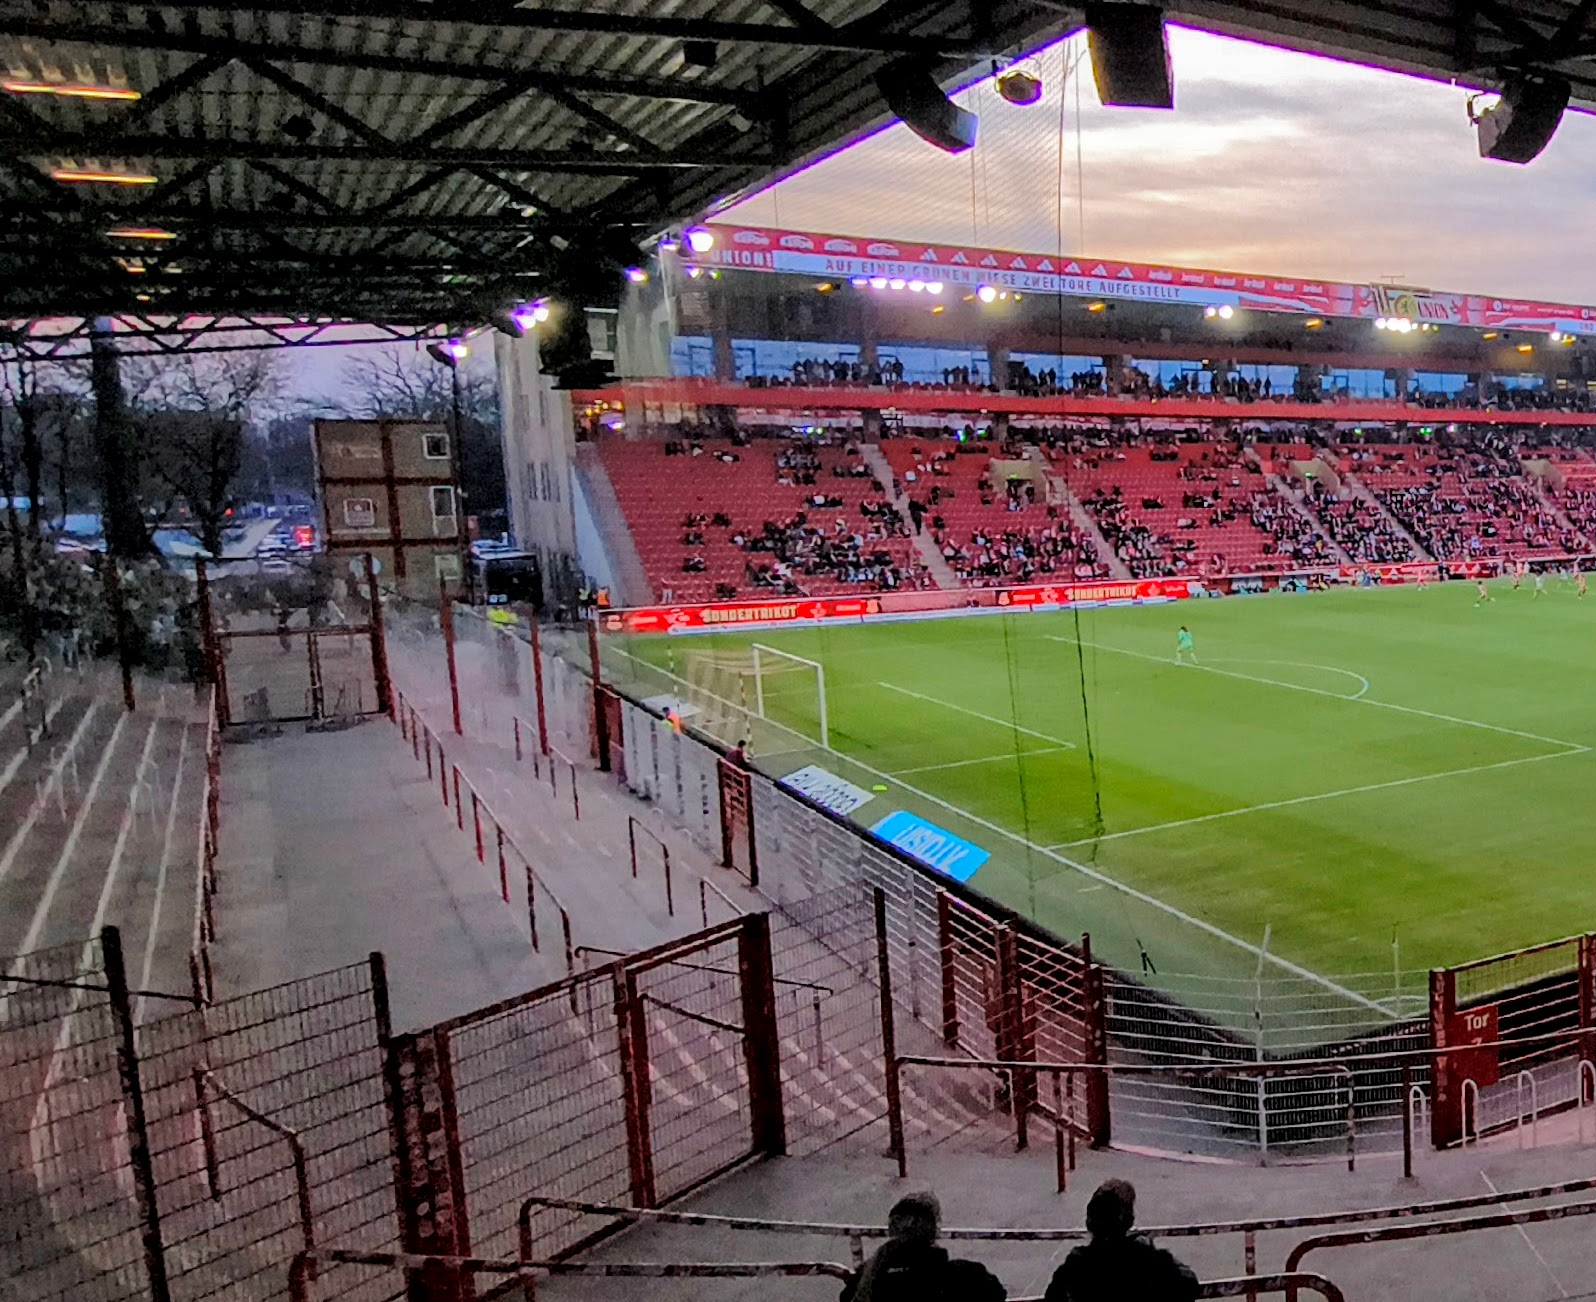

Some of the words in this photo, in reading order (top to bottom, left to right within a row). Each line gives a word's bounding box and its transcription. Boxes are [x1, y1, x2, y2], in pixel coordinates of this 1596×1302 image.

[826, 258, 853, 272] AUF
[1058, 278, 1092, 292] TORE
[1099, 281, 1181, 299] AUFGESTELLT
[701, 604, 798, 624] SONDERTRIKOT
[1463, 1012, 1490, 1032] Tor
